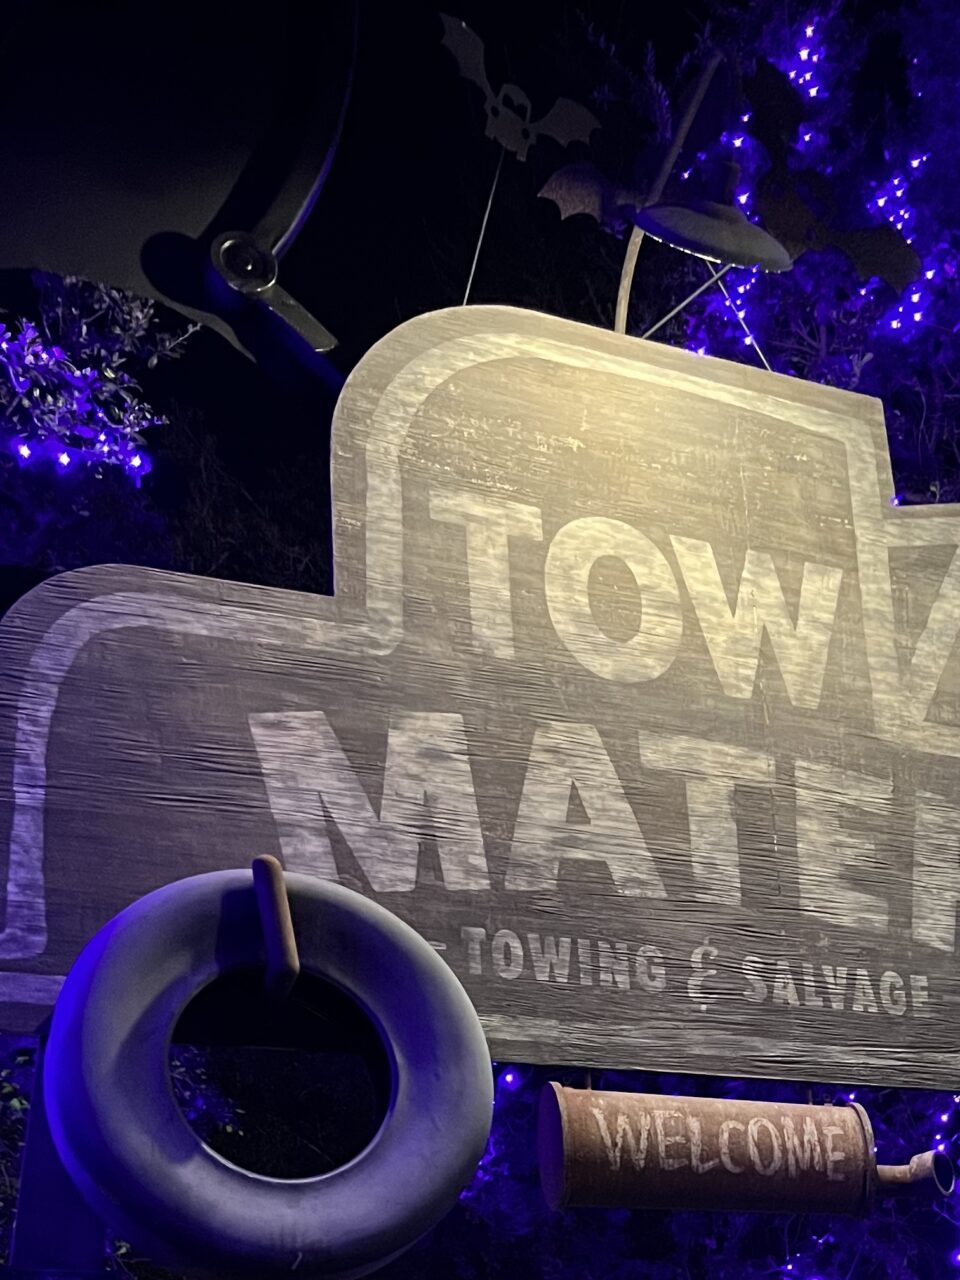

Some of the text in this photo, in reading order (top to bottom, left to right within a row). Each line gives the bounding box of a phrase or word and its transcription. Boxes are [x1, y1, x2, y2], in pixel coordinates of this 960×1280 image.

[428, 489, 843, 709] TOW
[461, 926, 667, 994] TOWING
[741, 955, 934, 1018] SALVAGE
[591, 1106, 846, 1182] WELCOME
